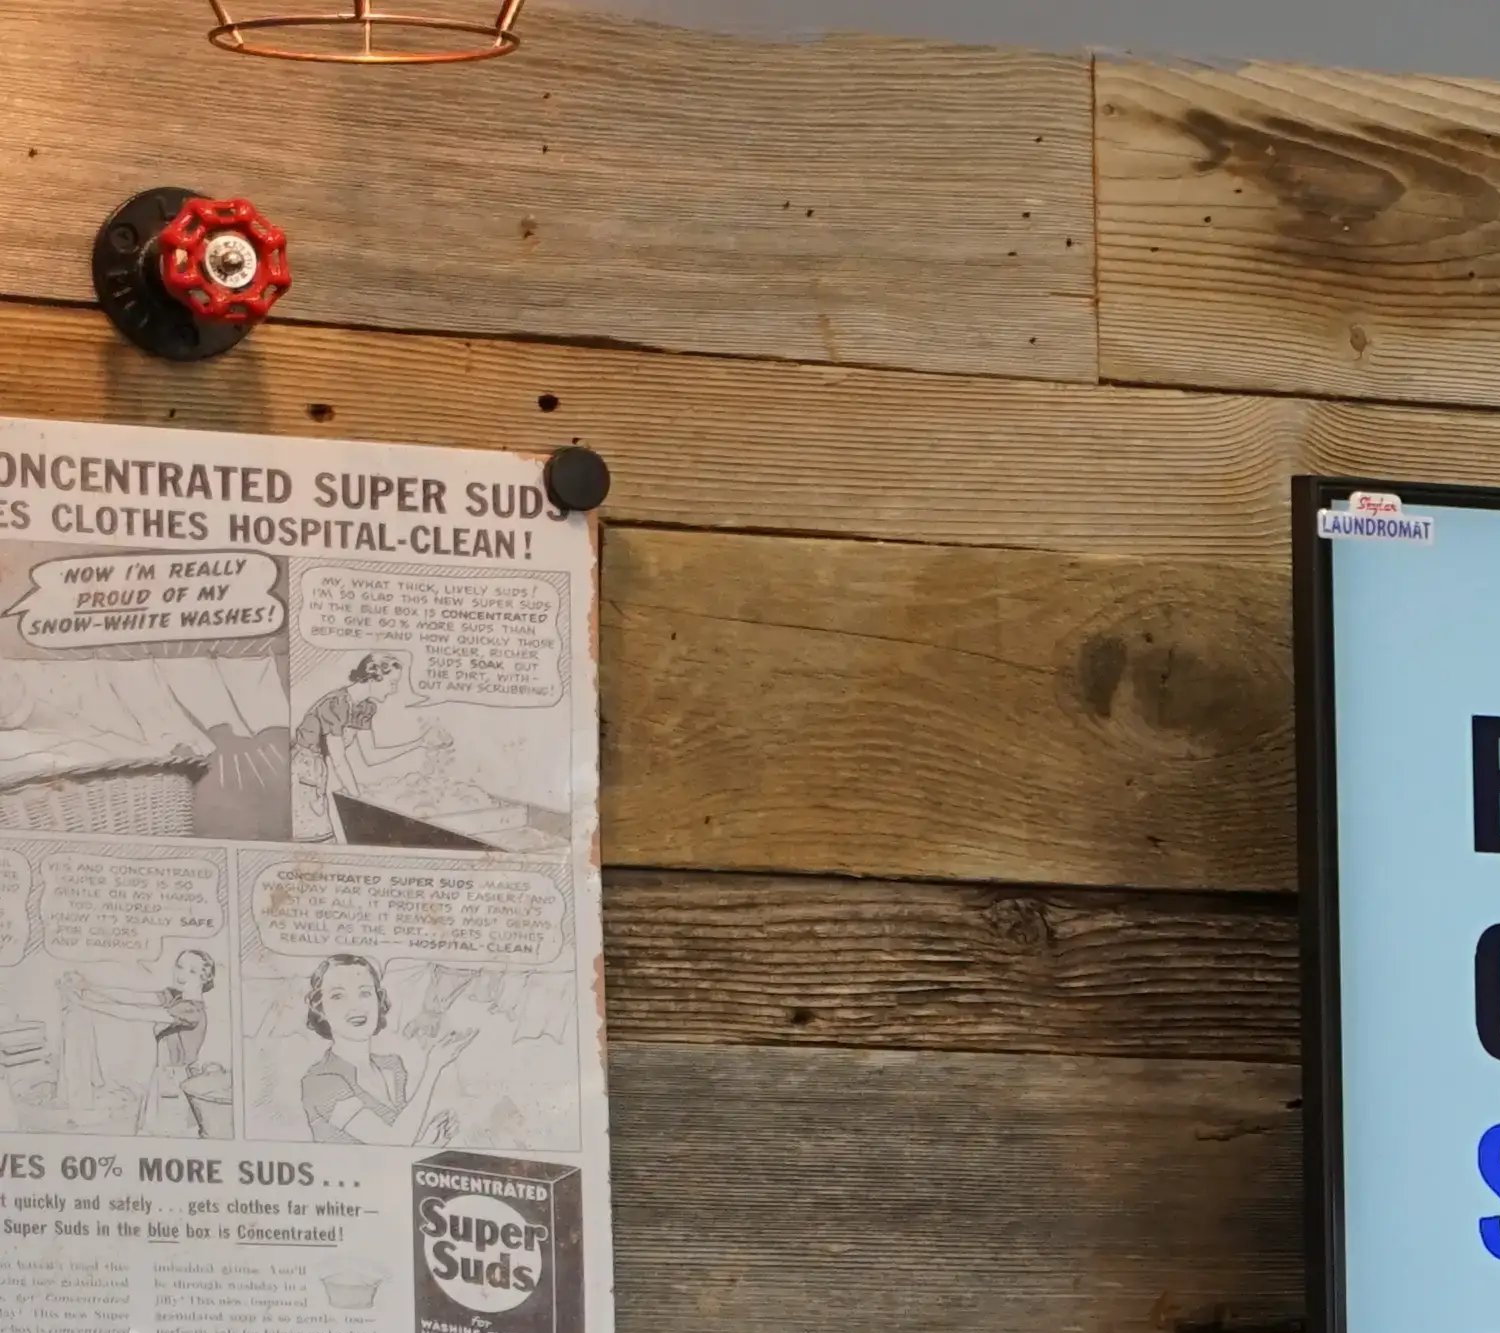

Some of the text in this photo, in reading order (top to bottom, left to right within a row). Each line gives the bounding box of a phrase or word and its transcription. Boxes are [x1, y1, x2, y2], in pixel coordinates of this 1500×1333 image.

[314, 472, 447, 516] SUPER
[52, 503, 209, 541] CLOTHES
[229, 514, 533, 560] HOSPITAL-CLEAN!
[1322, 515, 1431, 540] LAUNDROMAT
[64, 559, 247, 584] NOW I'M REALLY
[76, 585, 230, 608] PROUD OF MY
[352, 580, 390, 589] WHAT
[445, 585, 488, 596] LIVELY
[340, 591, 355, 599] SO
[362, 592, 394, 601] GLAD
[402, 594, 428, 604] THIS
[434, 597, 463, 606] NEW
[472, 598, 510, 608] SUPER
[520, 601, 552, 610] SUDS
[28, 606, 275, 636] SNOW-WHITE WASHES!
[361, 604, 388, 614] BLUE
[394, 606, 418, 616] BOX
[441, 609, 548, 623] CONCENTRATED
[344, 616, 371, 626] GIVE
[416, 621, 454, 631] MORE
[462, 623, 494, 633] SUDS
[501, 625, 536, 635] THAN
[420, 633, 449, 643] HOW
[518, 639, 554, 649] THOSE
[429, 657, 462, 667] SUDS
[470, 659, 504, 670] SOAK
[277, 870, 473, 889] CONCENTRATED SUPER SUDS
[180, 918, 214, 928] SAFE
[61, 1156, 122, 1181] 60%
[138, 1158, 223, 1184] MORE
[416, 1170, 548, 1201] CONCENTRATED
[14, 1193, 66, 1212] quickly
[74, 1195, 100, 1210] and
[108, 1195, 152, 1214] safely
[188, 1199, 219, 1216] gets
[227, 1199, 280, 1215] clothes
[287, 1200, 307, 1216] far
[4, 1218, 344, 1242] Super Suds in the blue box is Concentrated!
[419, 1197, 548, 1252] Super
[432, 1240, 538, 1292] Suds
